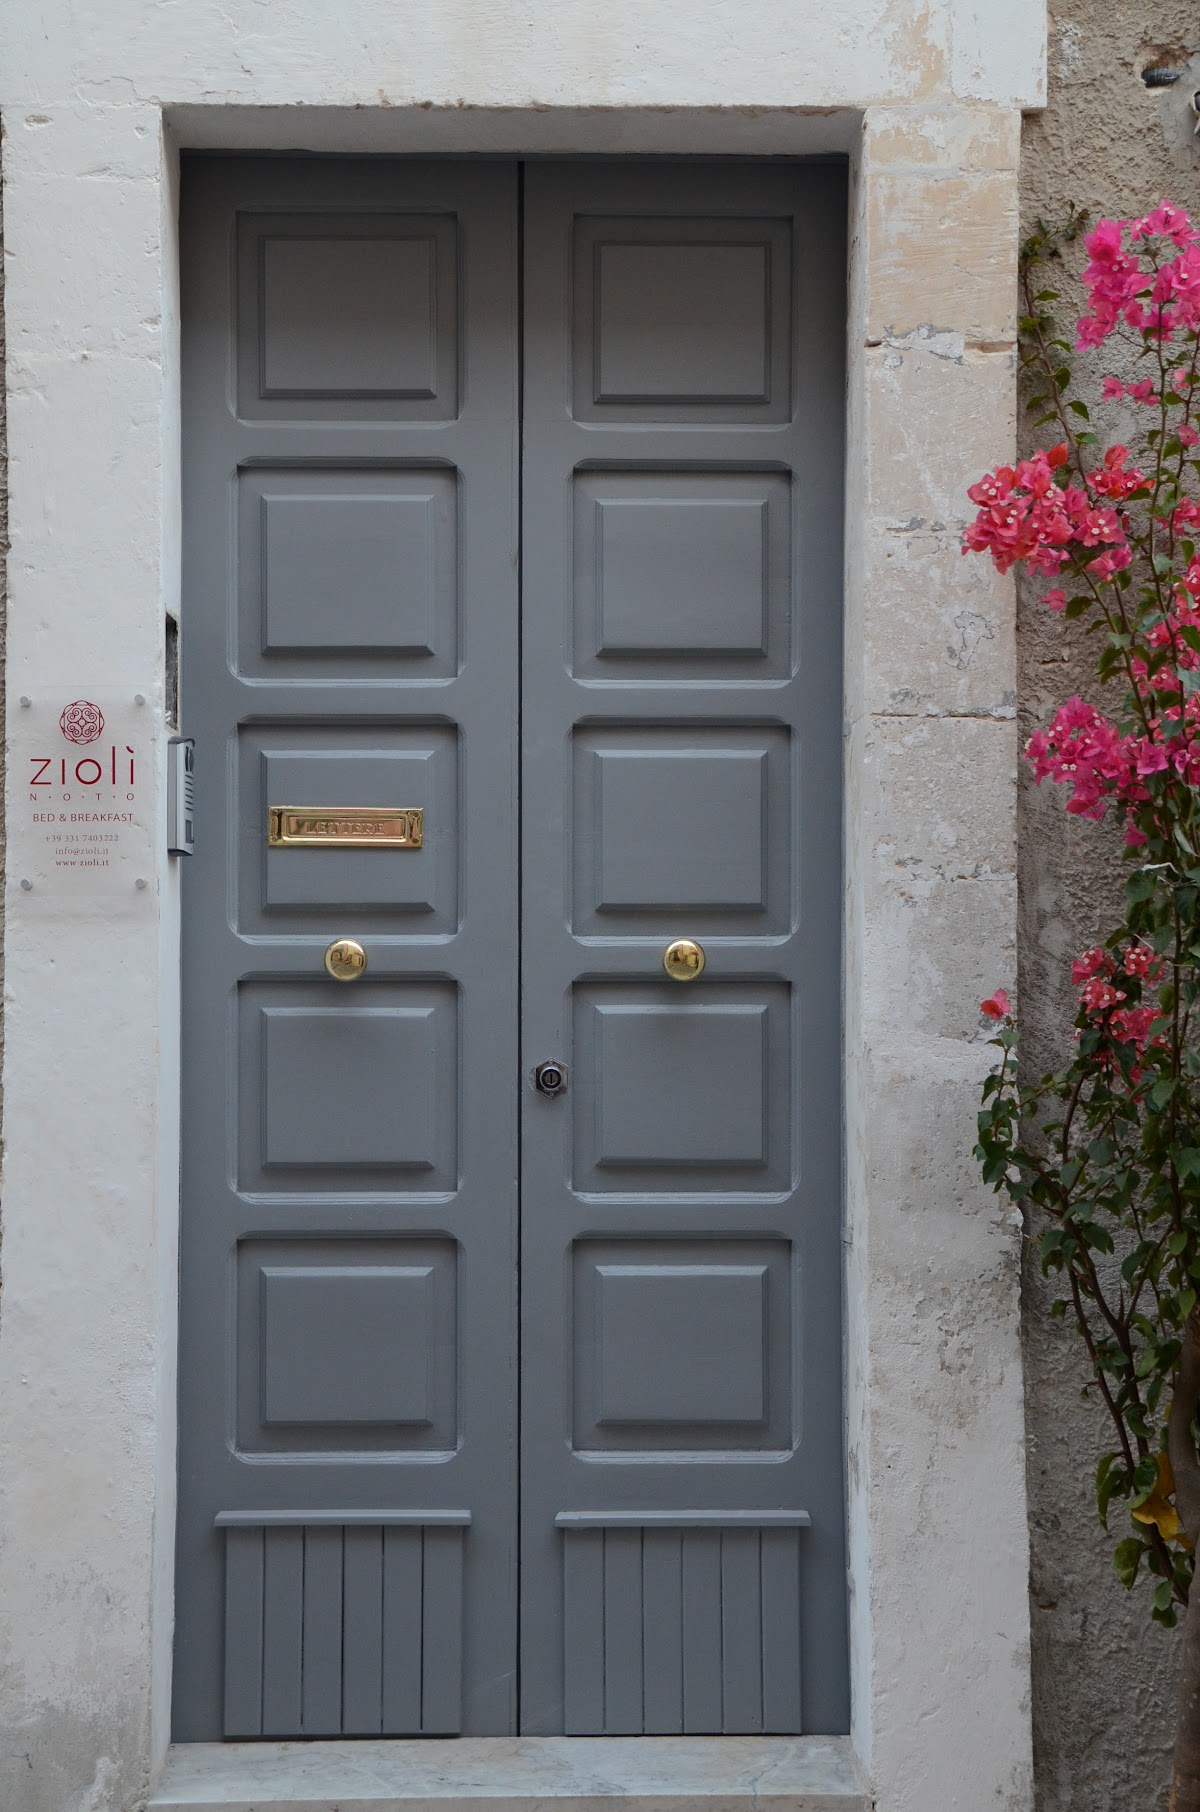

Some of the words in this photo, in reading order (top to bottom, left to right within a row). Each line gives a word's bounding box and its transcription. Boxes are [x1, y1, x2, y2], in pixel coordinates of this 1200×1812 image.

[33, 813, 55, 823] BED
[59, 813, 67, 823] &
[70, 813, 134, 822] BREAKFAST
[306, 822, 385, 835] LETTERE
[45, 834, 62, 843] +39
[64, 834, 79, 843] 331
[82, 834, 119, 843] 7403222
[55, 847, 109, 856] info@zioli.it
[55, 858, 109, 867] wwwzioli.it
